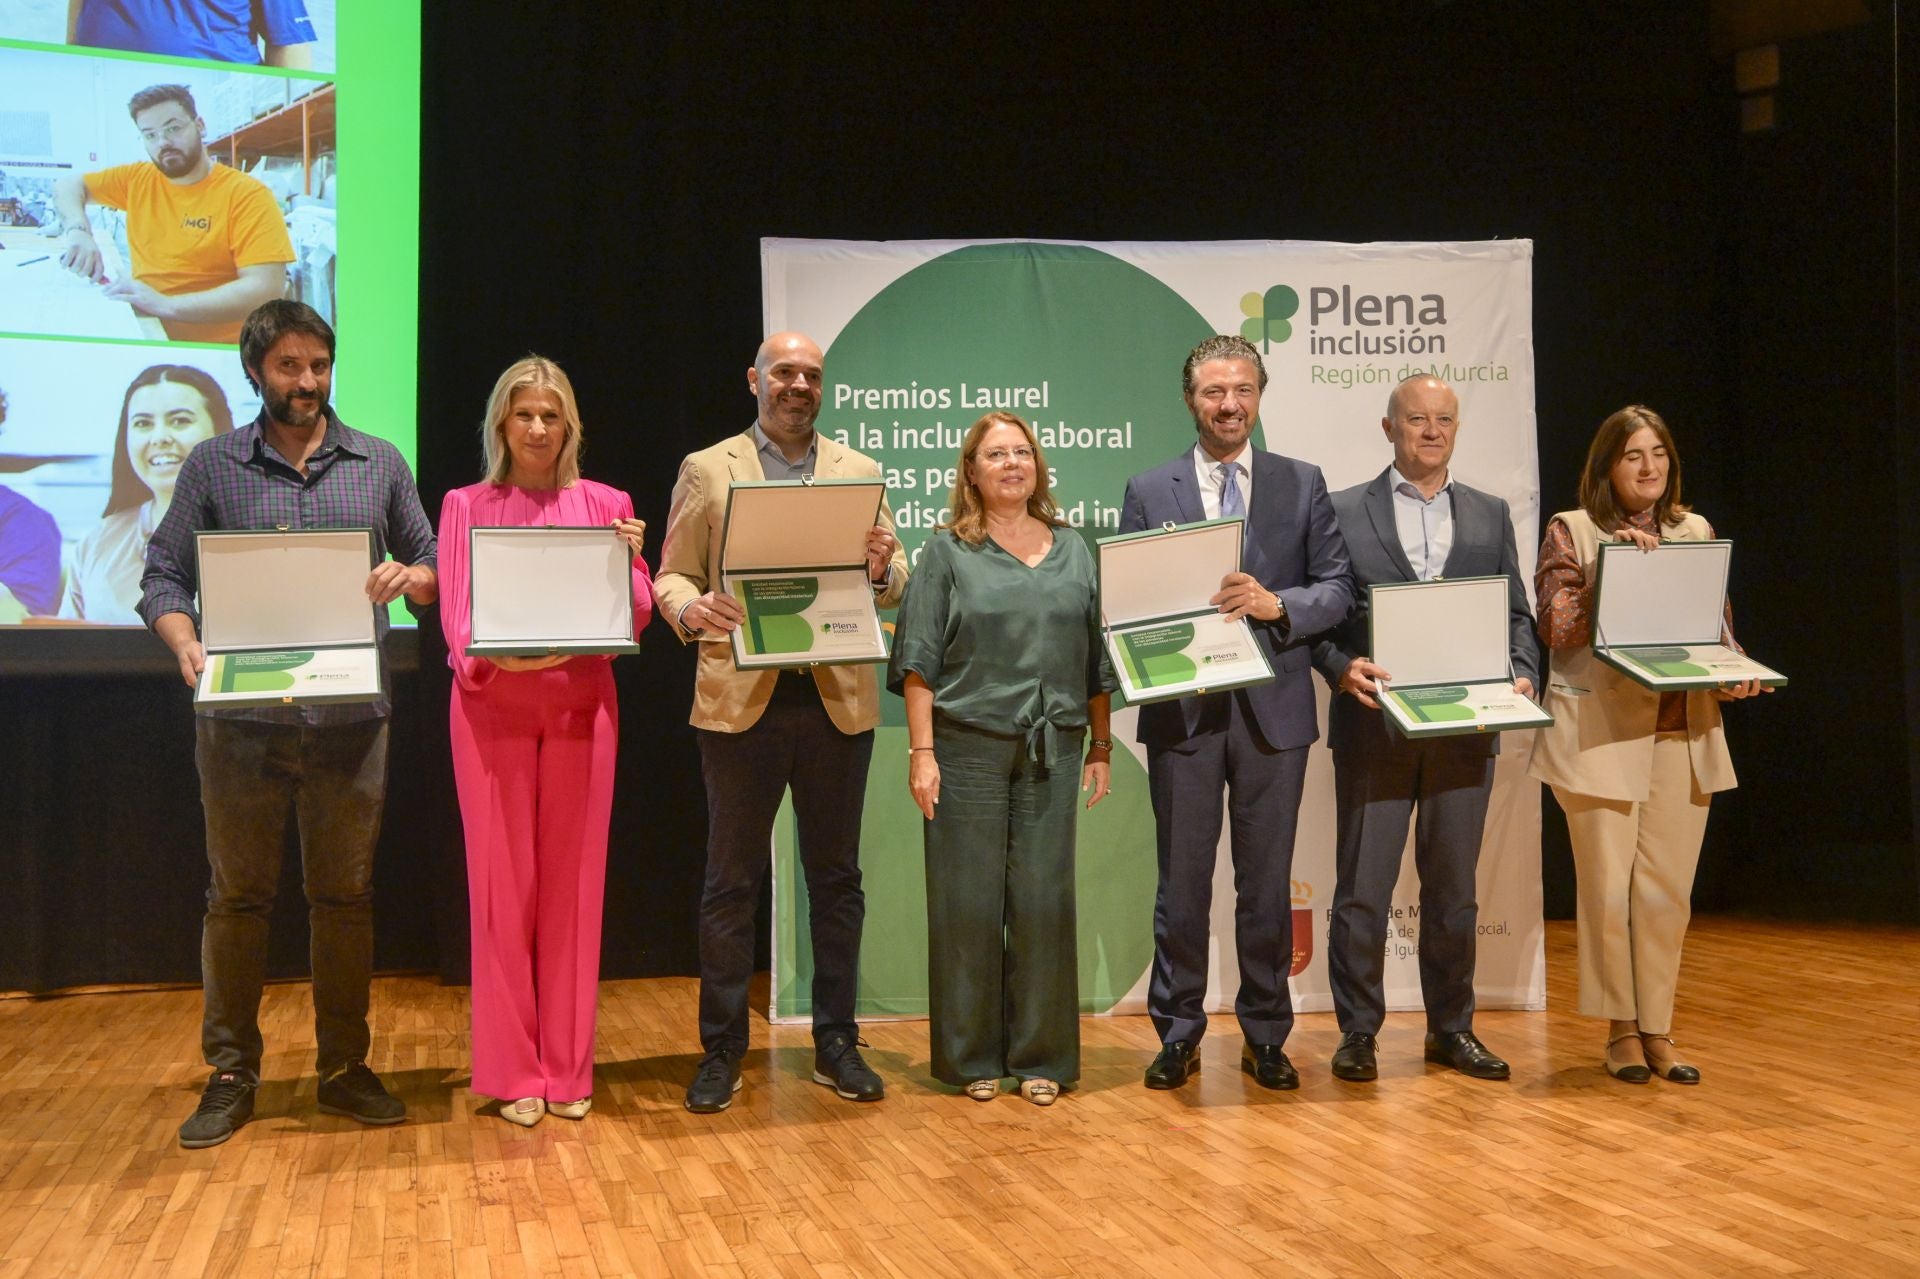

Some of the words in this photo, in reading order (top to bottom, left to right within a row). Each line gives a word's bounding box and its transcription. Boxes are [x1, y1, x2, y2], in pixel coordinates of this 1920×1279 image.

[1310, 284, 1447, 326] Plena
[1310, 327, 1445, 355] inclusión
[1311, 363, 1391, 389] Región
[1430, 361, 1509, 384] Murcia
[834, 381, 951, 409] Premios
[960, 381, 1049, 408] Laurel
[860, 422, 883, 449] la
[893, 421, 970, 449] inclu
[1031, 420, 1132, 449] laboral
[1398, 923, 1415, 938] de
[1476, 921, 1511, 936] ocial,
